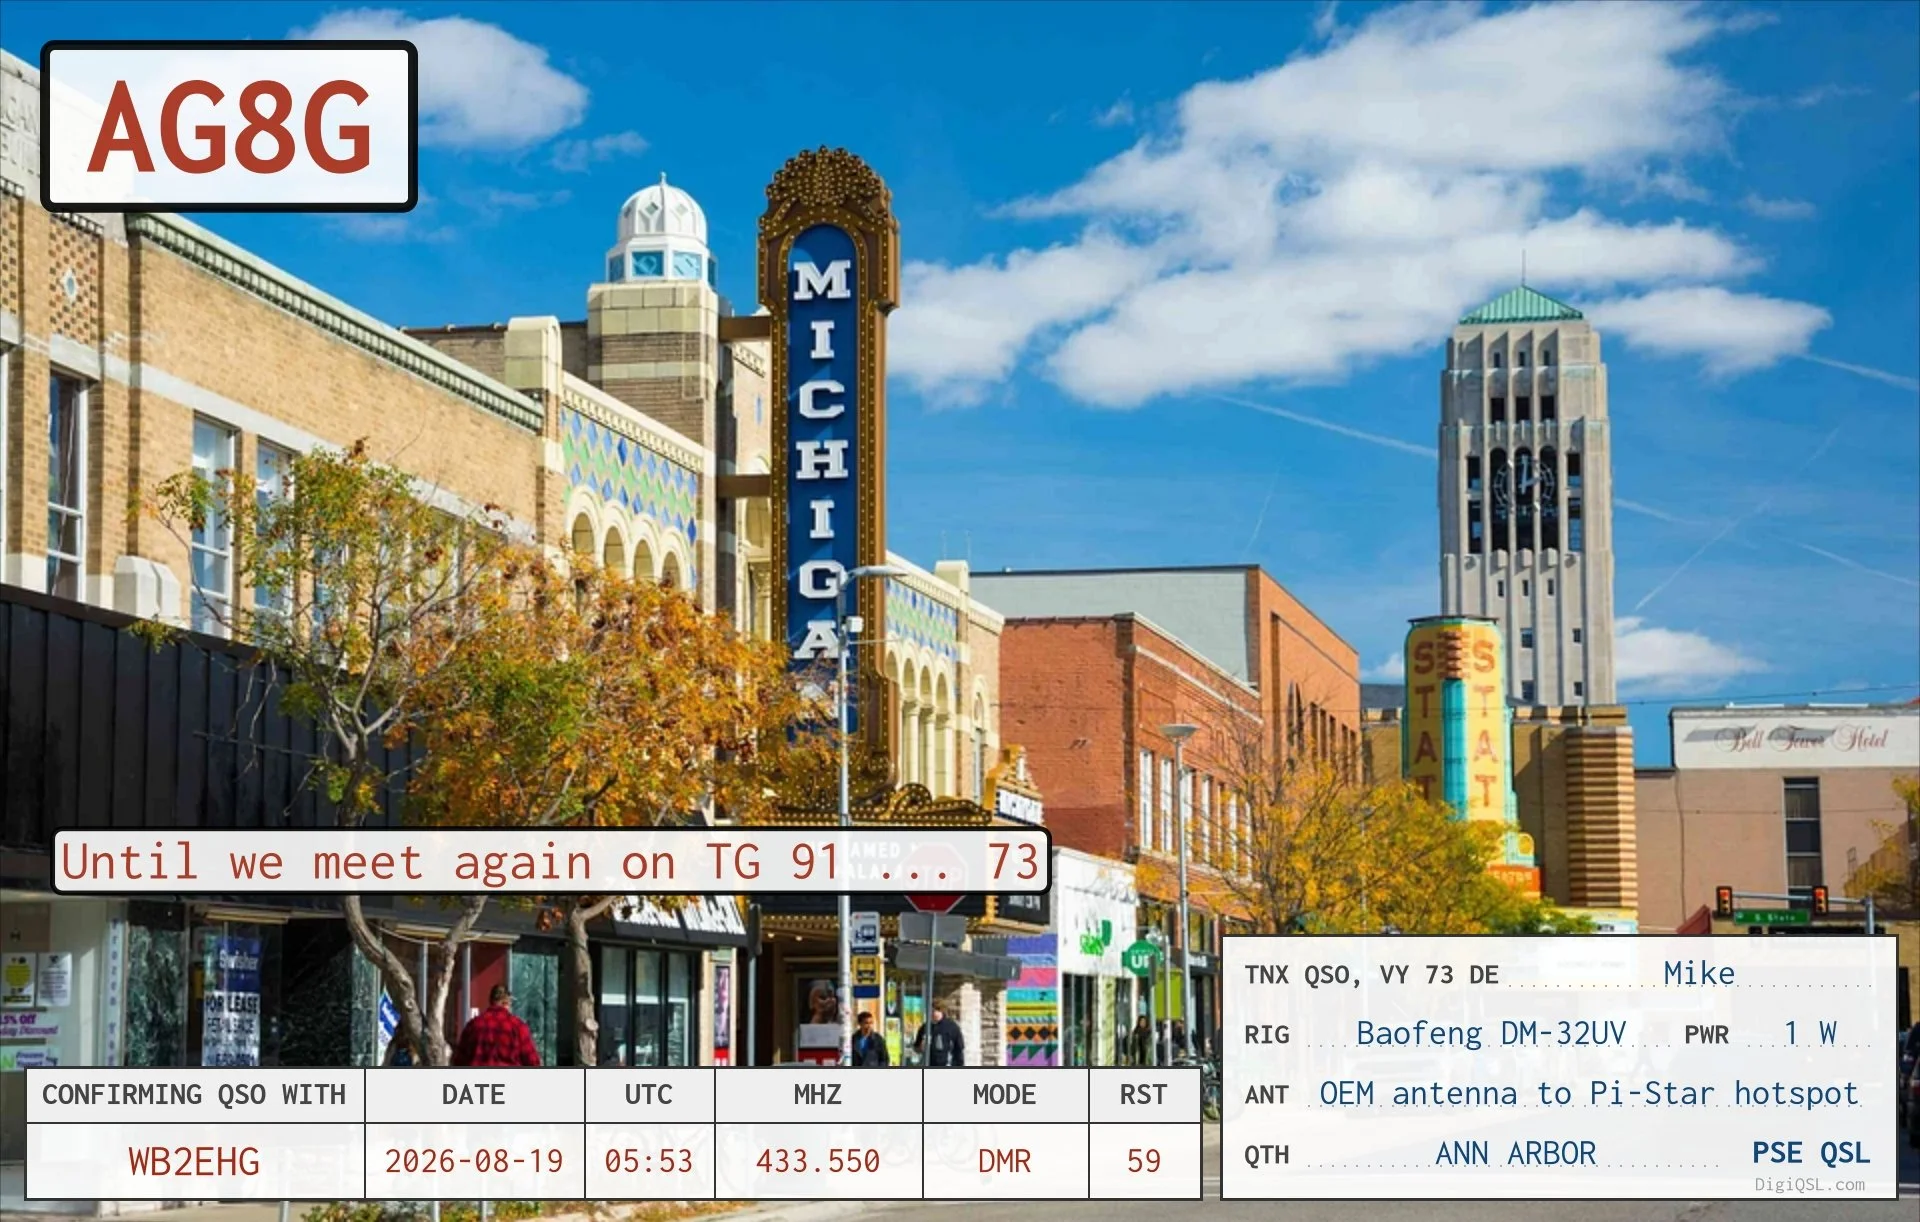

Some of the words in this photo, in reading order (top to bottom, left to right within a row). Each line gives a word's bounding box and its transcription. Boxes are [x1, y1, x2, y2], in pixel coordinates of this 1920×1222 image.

[1714, 724, 1764, 752] Bell
[1768, 724, 1826, 752] Tower
[1831, 721, 1889, 752] Hotel
[227, 994, 259, 1015] LEASE
